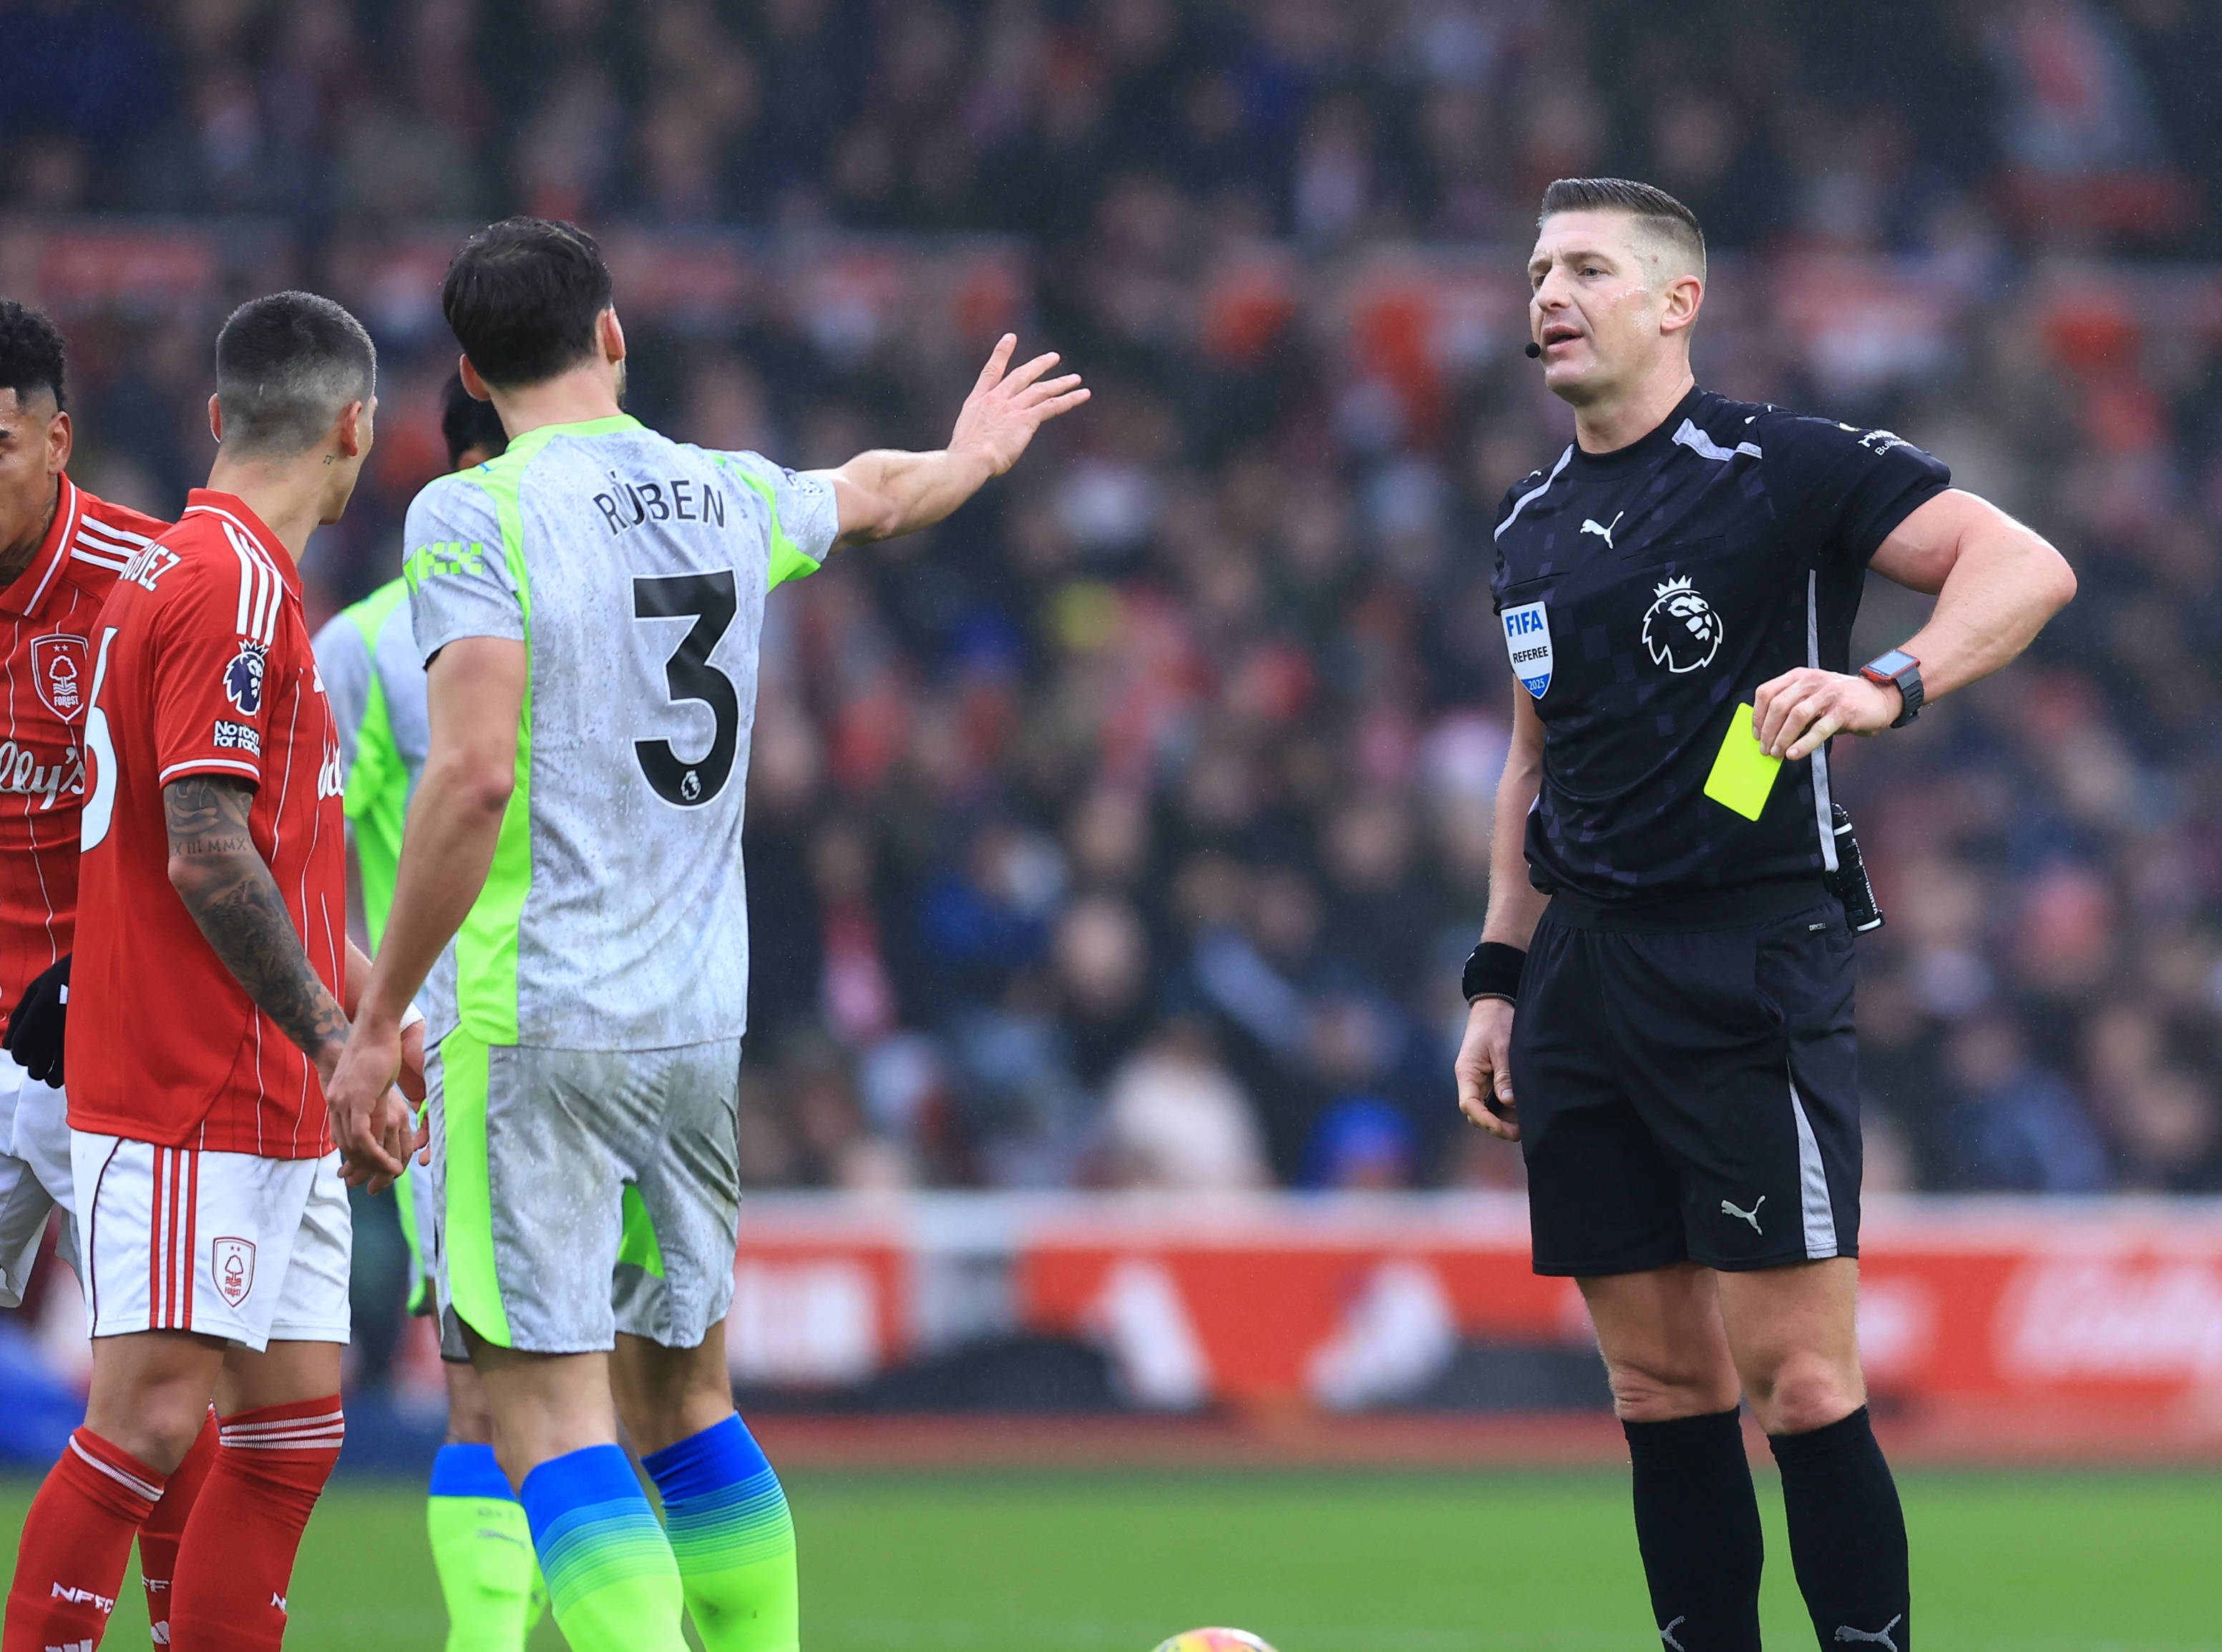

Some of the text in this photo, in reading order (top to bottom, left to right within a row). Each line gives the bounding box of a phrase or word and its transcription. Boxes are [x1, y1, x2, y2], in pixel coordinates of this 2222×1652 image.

[593, 471, 725, 536] RÚBEN
[1506, 610, 1544, 637] FIFA
[1513, 645, 1549, 664] REFEREE
[634, 570, 739, 807] 3
[1528, 678, 1545, 690] 2025
[215, 720, 237, 735] No
[213, 733, 236, 747] for
[51, 1581, 114, 1614] NFFC
